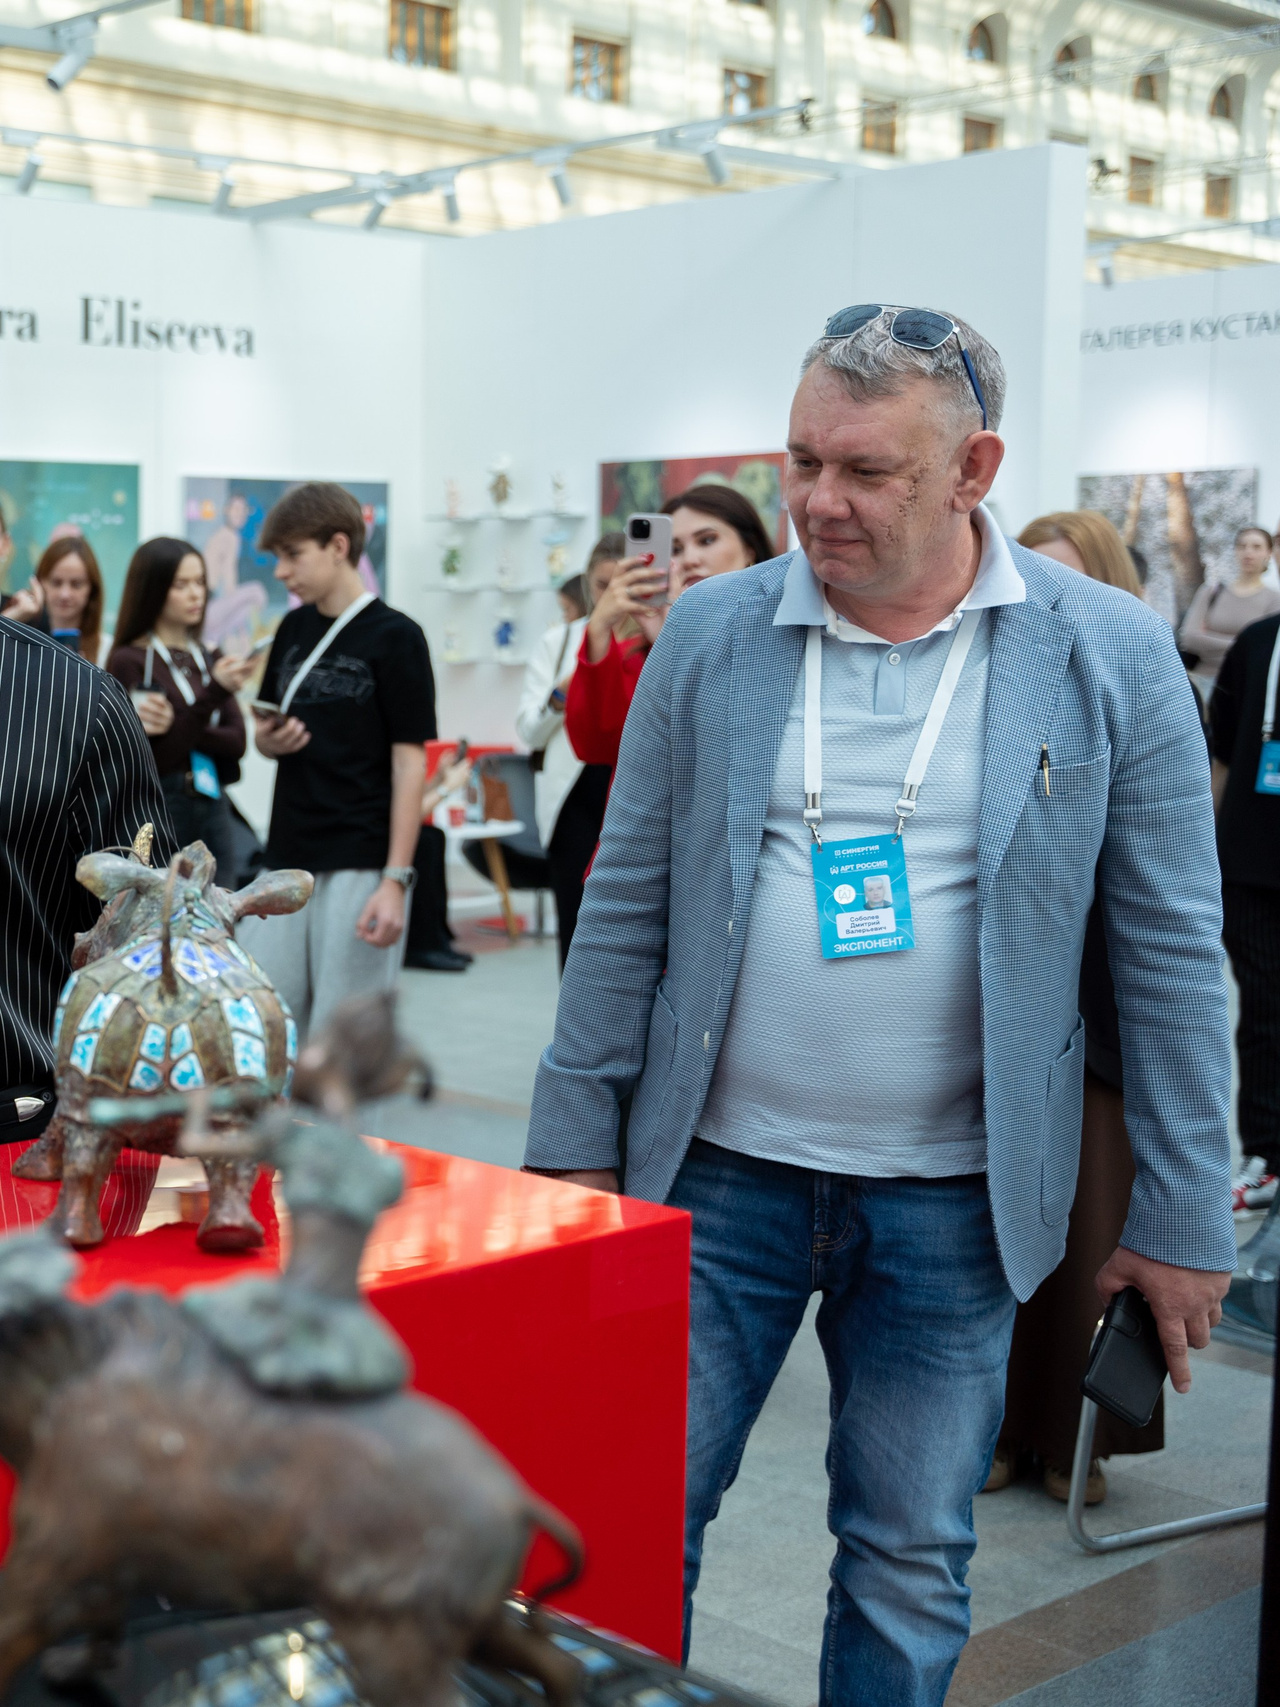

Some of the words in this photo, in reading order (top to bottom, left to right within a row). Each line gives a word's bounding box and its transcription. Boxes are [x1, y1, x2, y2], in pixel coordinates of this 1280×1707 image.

[80, 294, 255, 358] Eliseeva
[1080, 318, 1184, 354] ГАЛЕРЕЯ
[841, 845, 880, 855] СИНЕРГИЯ
[840, 864, 855, 872] АРТ
[856, 860, 888, 870] РОССИЯ
[845, 926, 887, 935] Валерьевич
[850, 920, 880, 929] Дмитрий
[833, 936, 904, 953] ЭКСПОНЕНТ
